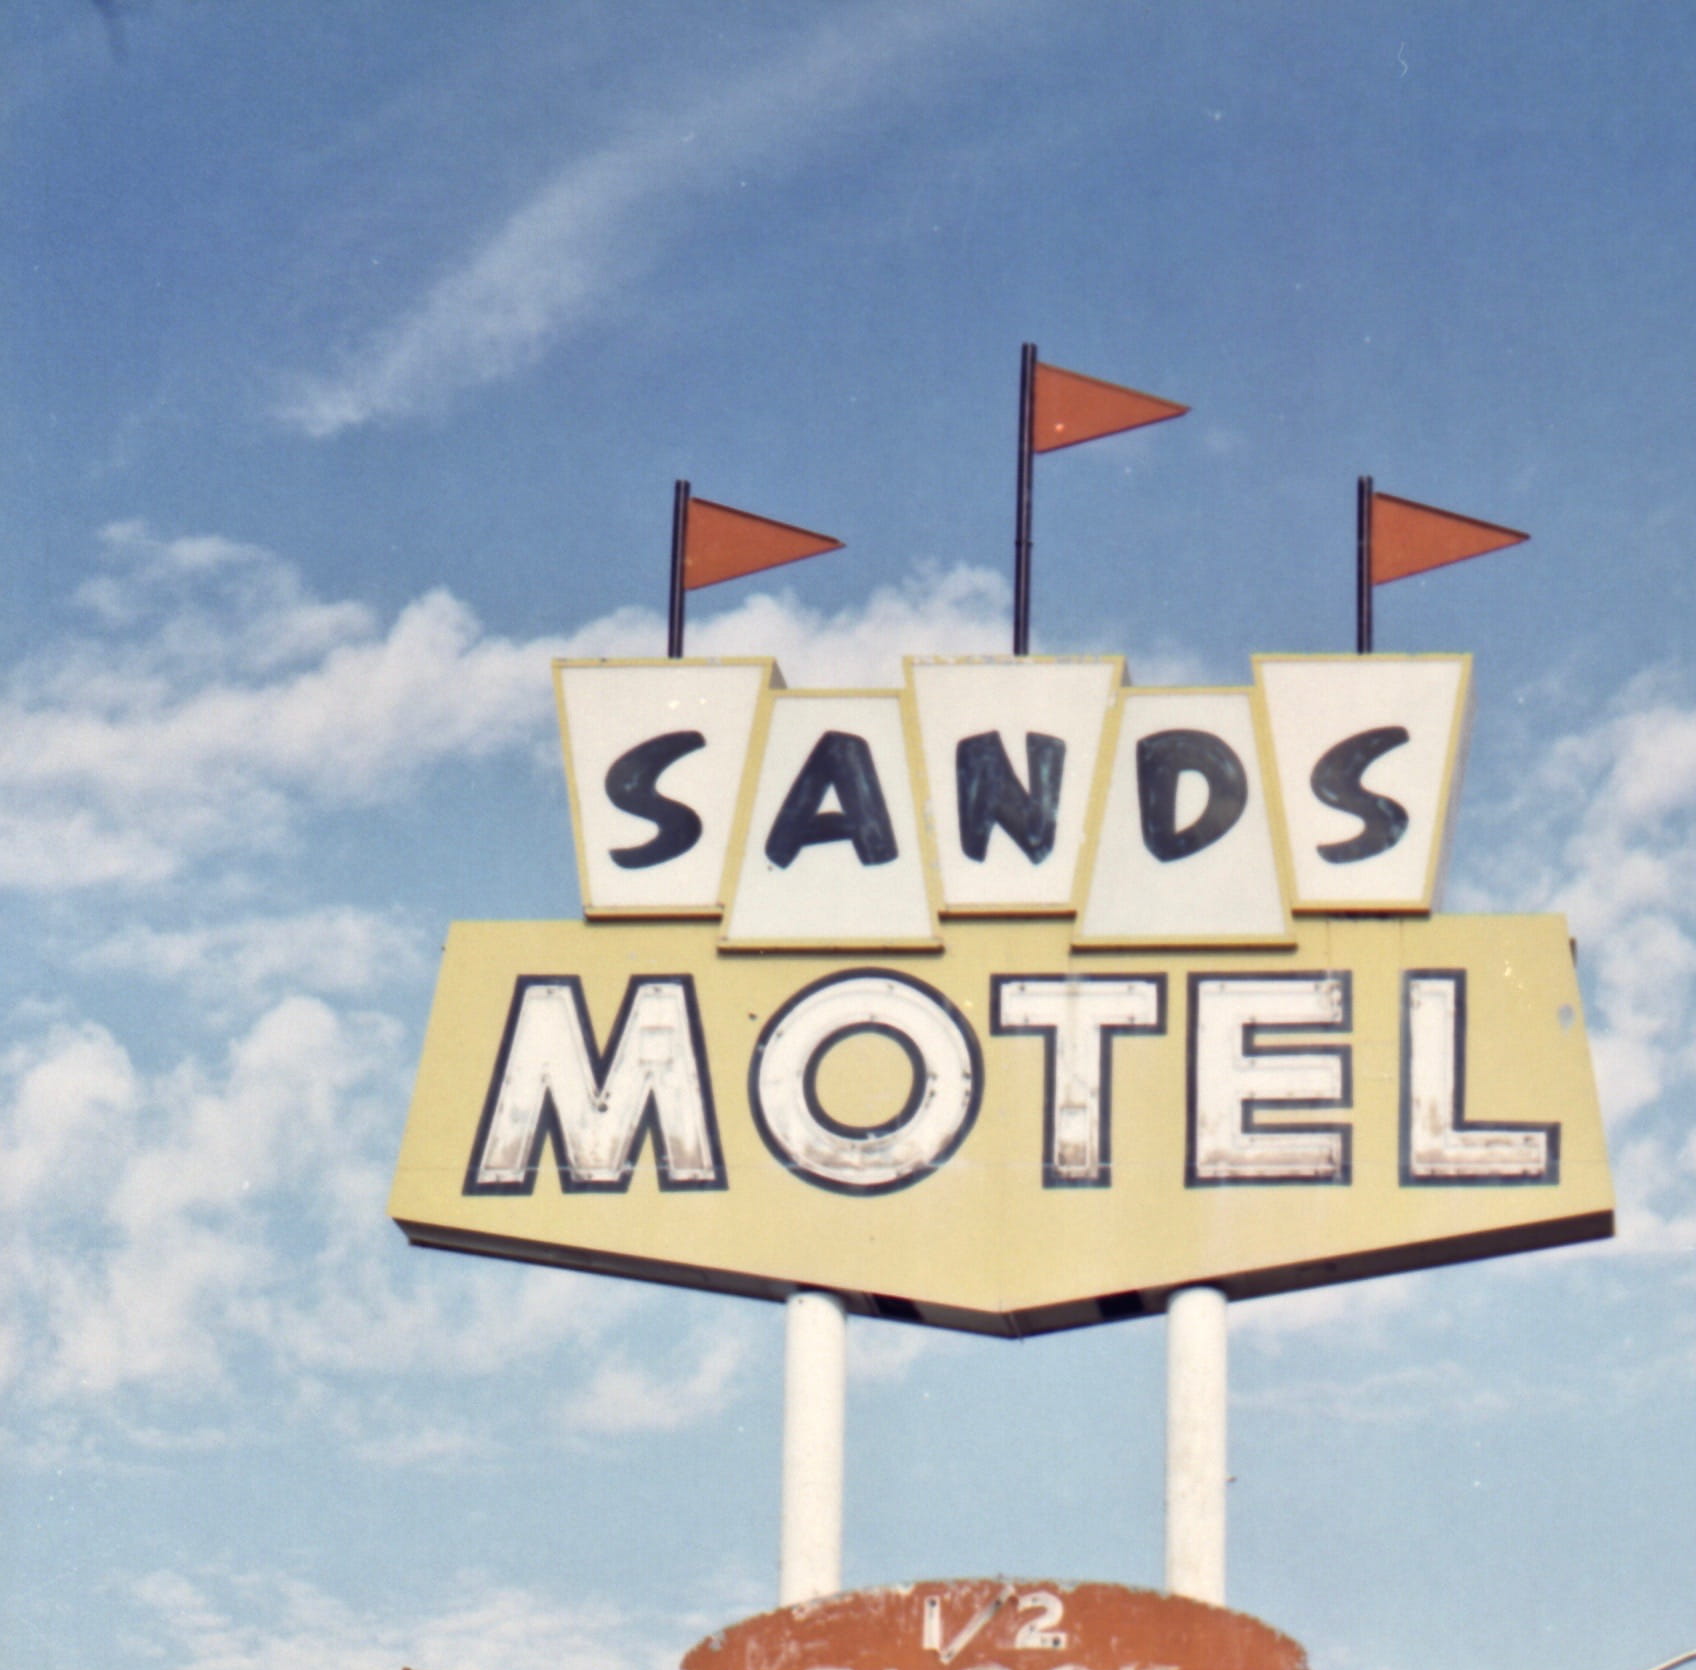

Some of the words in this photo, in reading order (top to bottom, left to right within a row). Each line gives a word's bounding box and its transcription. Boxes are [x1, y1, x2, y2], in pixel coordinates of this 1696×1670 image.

[603, 725, 1411, 869] SANDS
[461, 966, 1561, 1195] MOTEL
[922, 1584, 1067, 1665] 1/2
